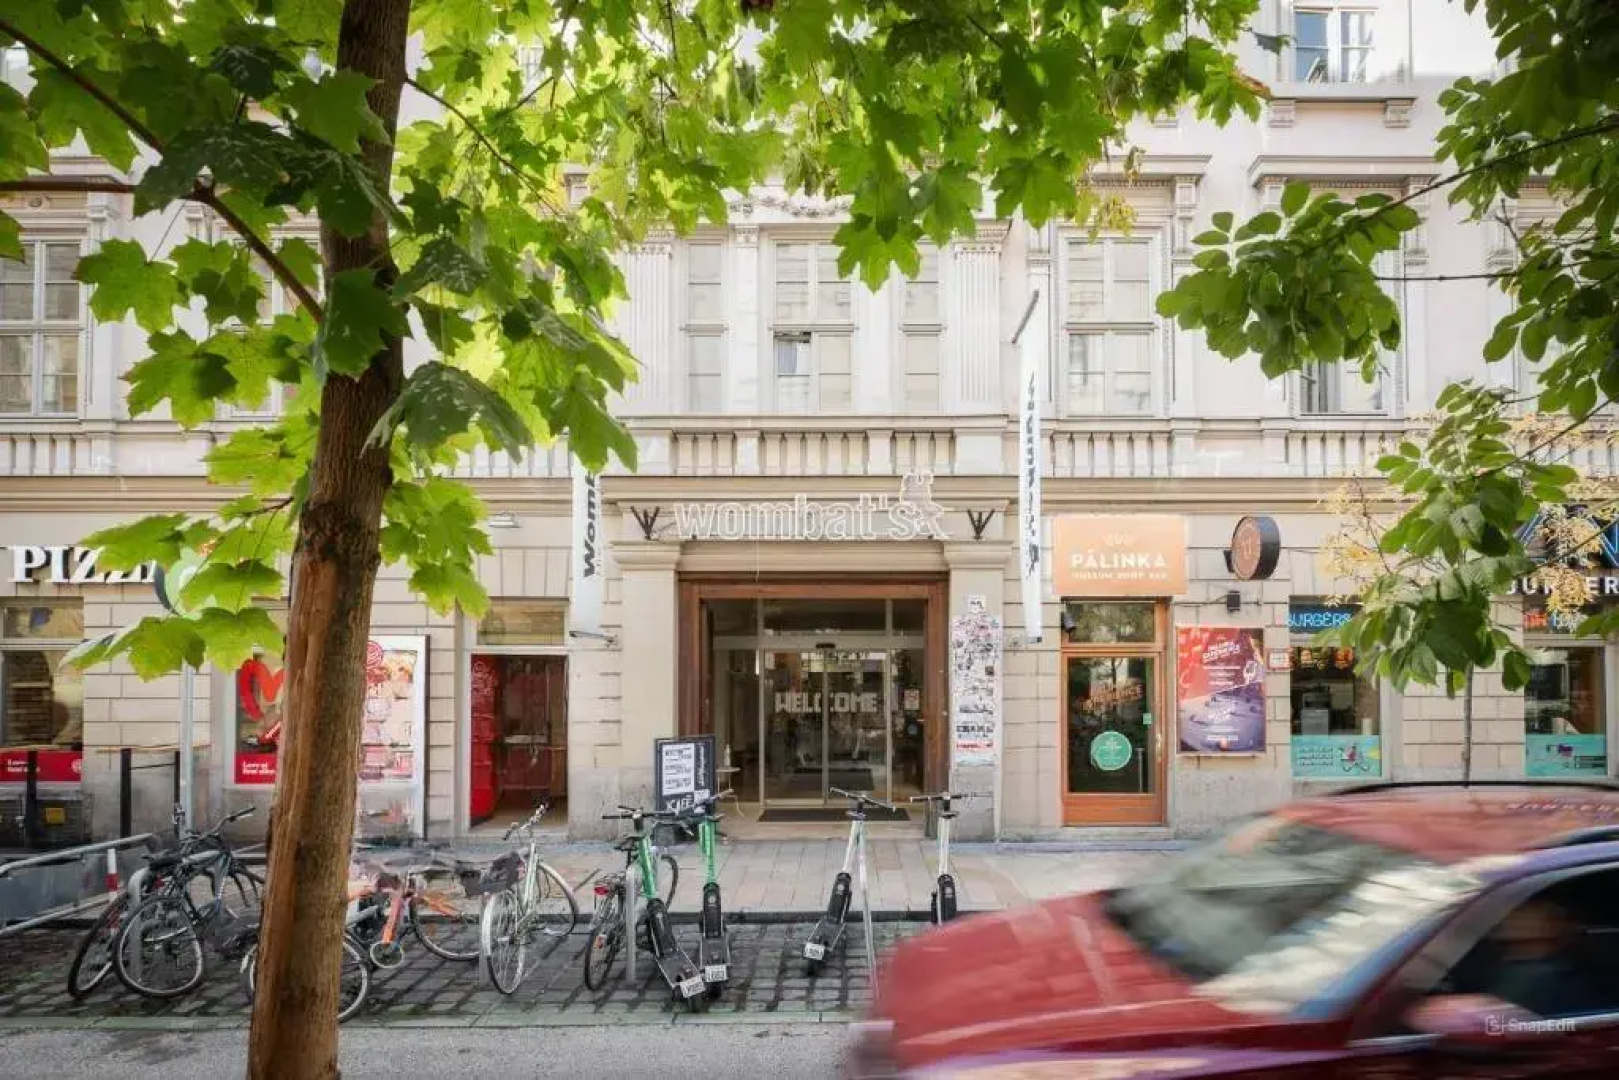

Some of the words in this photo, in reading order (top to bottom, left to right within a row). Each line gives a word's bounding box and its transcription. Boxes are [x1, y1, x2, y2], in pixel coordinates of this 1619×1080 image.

[674, 493, 923, 540] wombat's
[8, 545, 156, 583] PIZ
[1071, 548, 1166, 569] PÁLINKA
[774, 691, 878, 713] WELCOME
